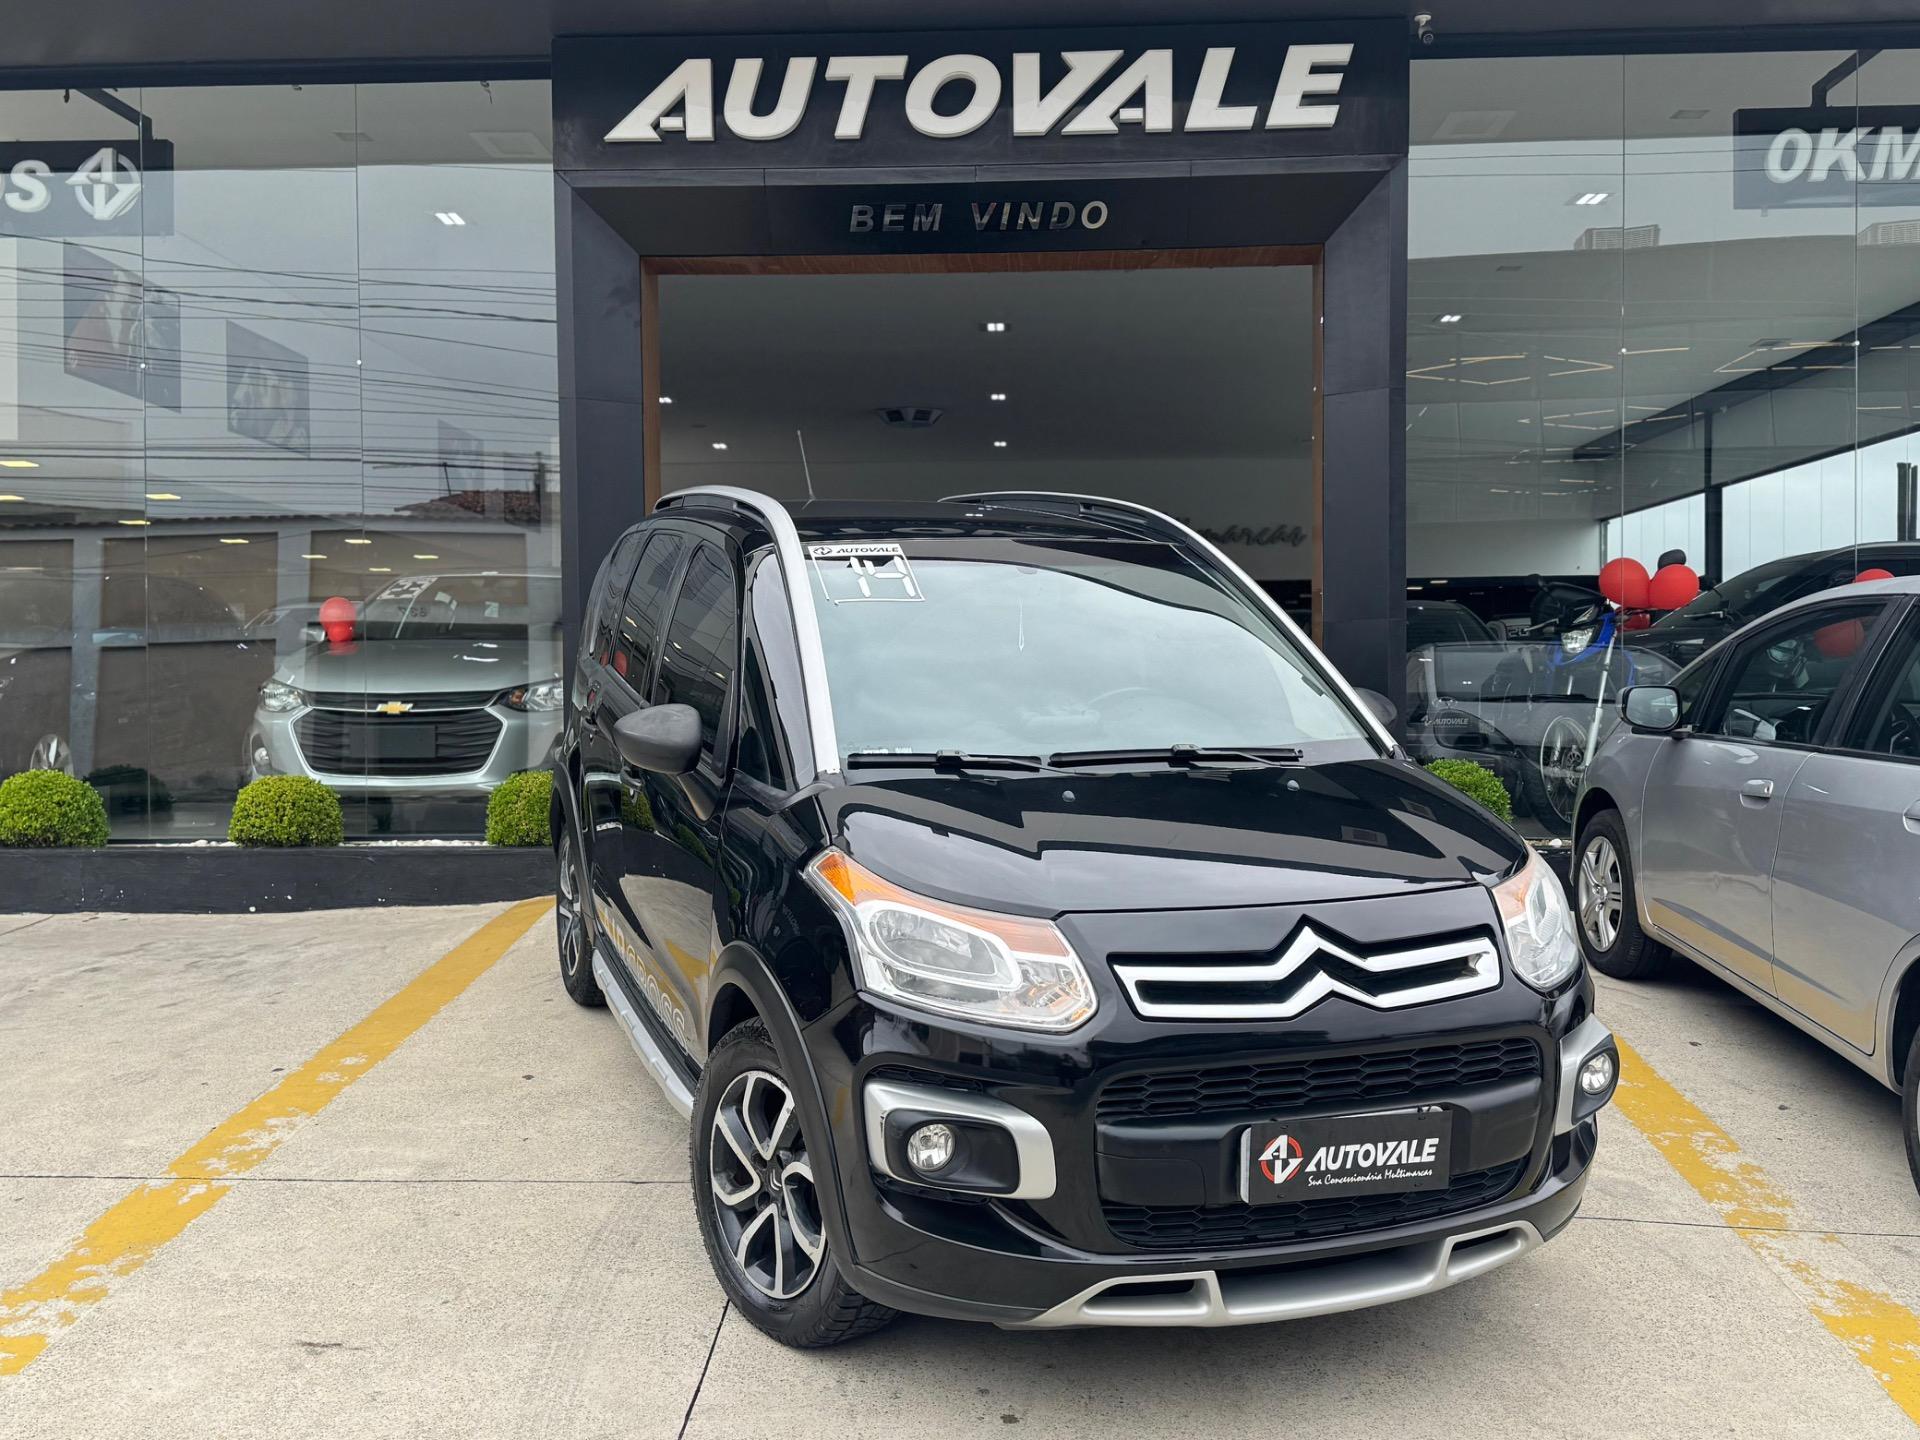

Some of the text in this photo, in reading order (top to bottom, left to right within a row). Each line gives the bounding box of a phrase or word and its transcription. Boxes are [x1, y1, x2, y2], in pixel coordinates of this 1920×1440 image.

[603, 42, 1354, 142] AUTOVALE
[0, 159, 54, 213] S
[849, 200, 1109, 233] BEM VINDO
[836, 546, 900, 554] AUTOVALE
[849, 556, 917, 598] 14
[1304, 1137, 1440, 1173] AUTOVALE
[1307, 1175, 1323, 1187] Sua
[1384, 1168, 1433, 1180] Multimarcas
